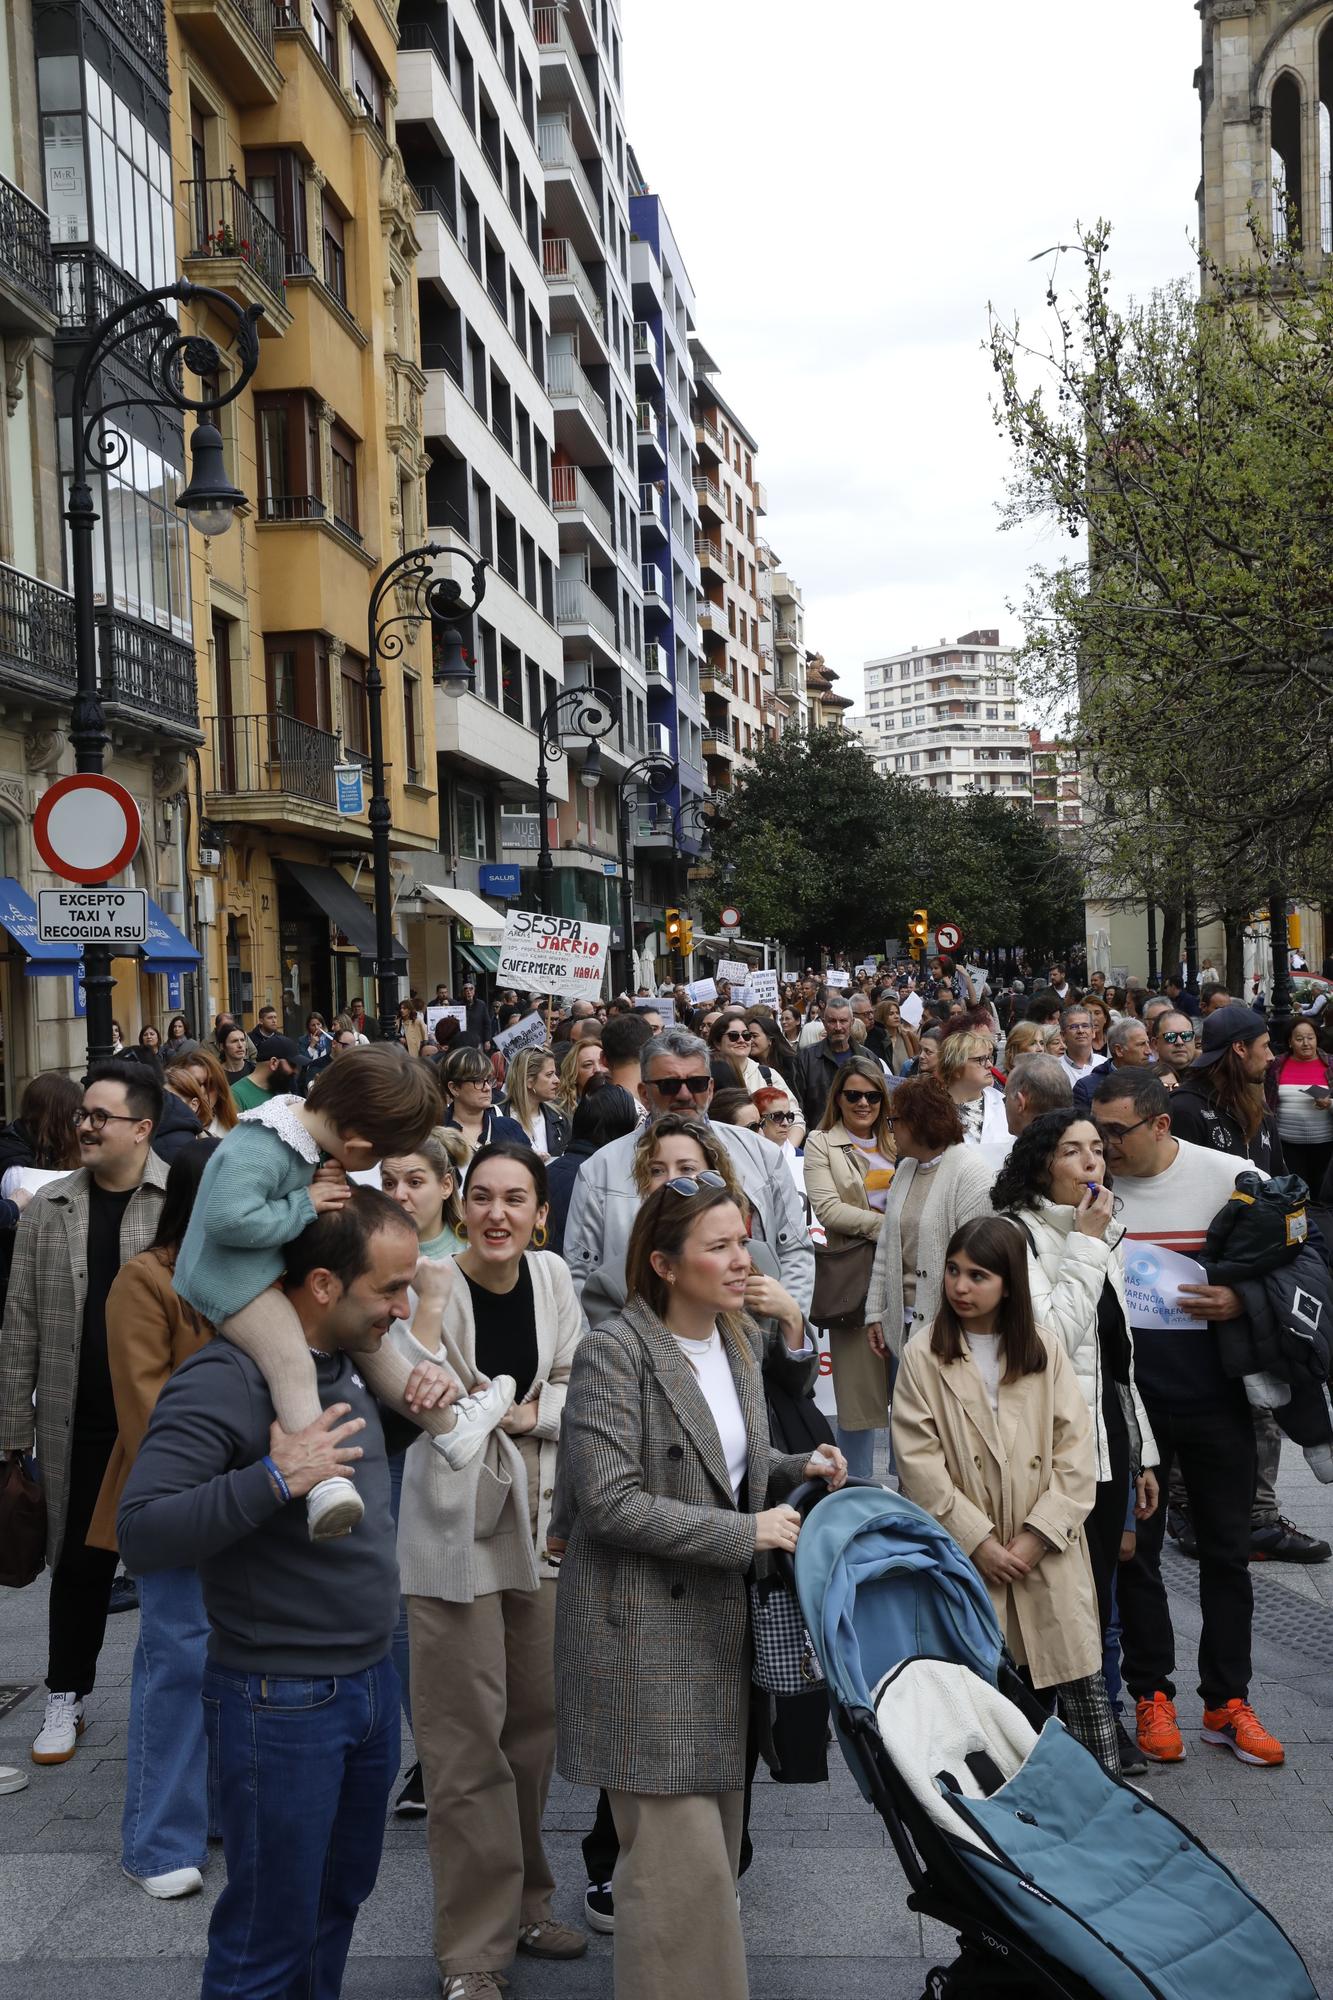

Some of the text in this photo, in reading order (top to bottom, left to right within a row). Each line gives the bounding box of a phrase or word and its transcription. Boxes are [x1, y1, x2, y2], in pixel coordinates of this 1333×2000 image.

[512, 823, 541, 834] NUEV
[59, 894, 125, 906] EXCEPTO
[68, 910, 116, 922] TAXI Y
[44, 926, 112, 938] RECOGIDA
[114, 926, 141, 938] RSU
[512, 913, 581, 940] SESPA
[502, 958, 567, 977] ENFERMERAS
[1125, 1288, 1165, 1305] ARENCIA
[1139, 1303, 1150, 1312] LA
[981, 1930, 1009, 1956] YOYO
